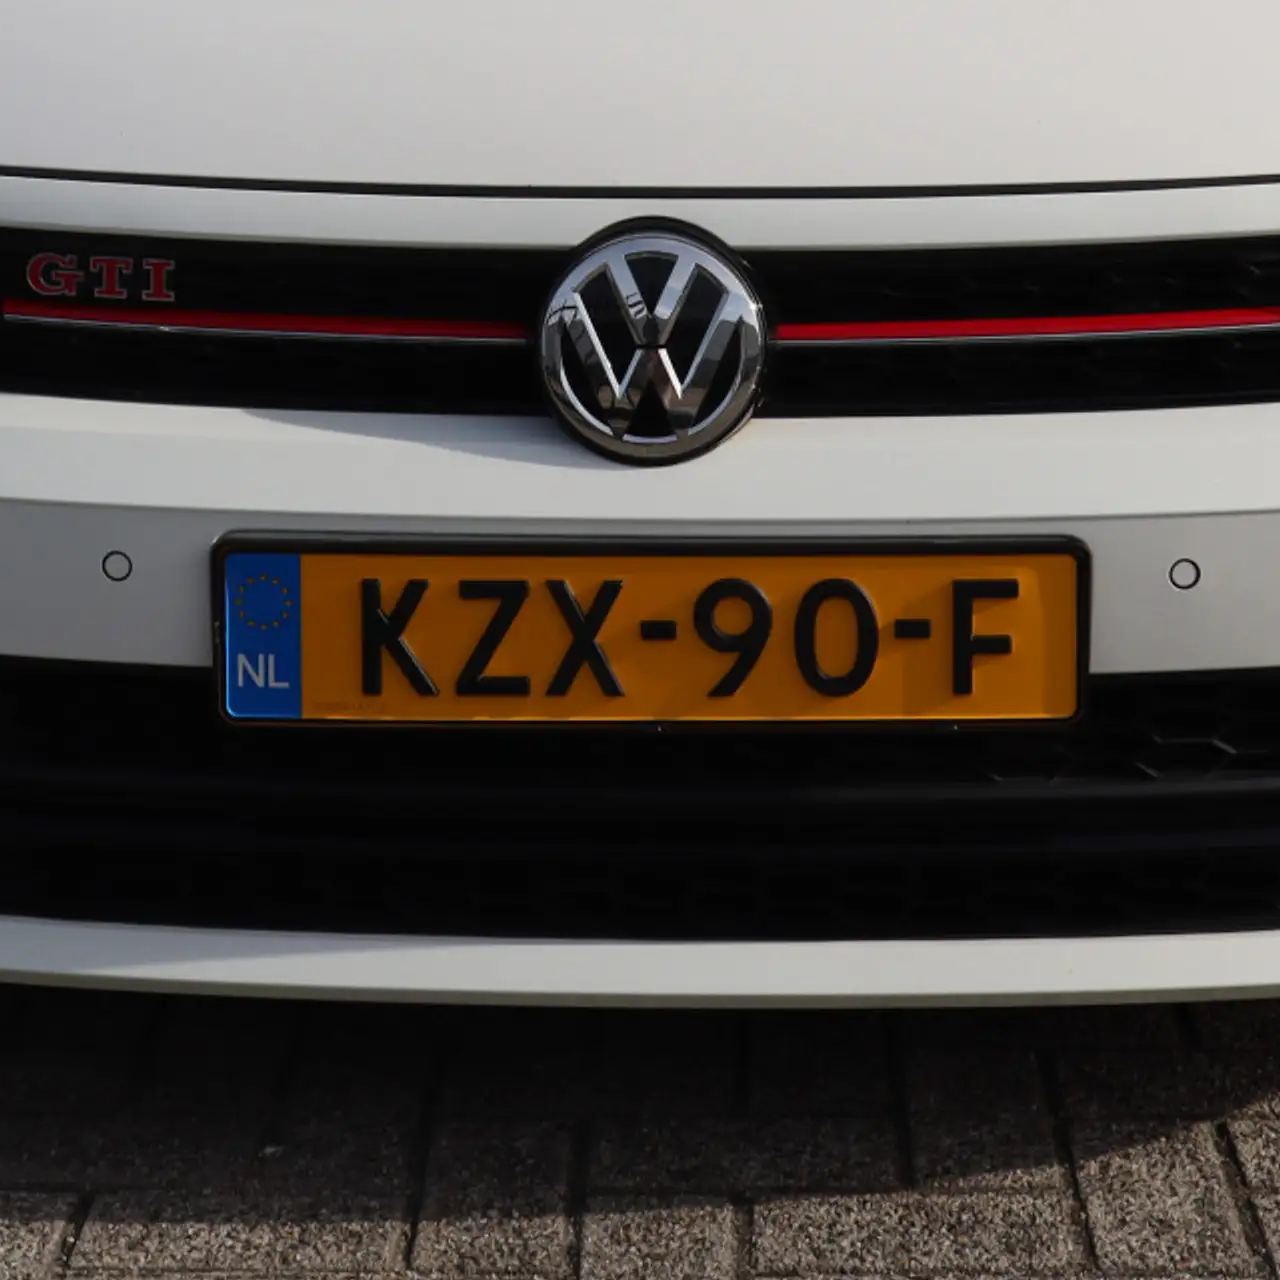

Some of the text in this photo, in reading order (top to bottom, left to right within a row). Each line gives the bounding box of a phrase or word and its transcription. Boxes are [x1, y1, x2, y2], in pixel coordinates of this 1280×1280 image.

[26, 253, 175, 301] GTI
[359, 578, 1019, 700] KZX-90-F
[237, 654, 289, 688] NL
